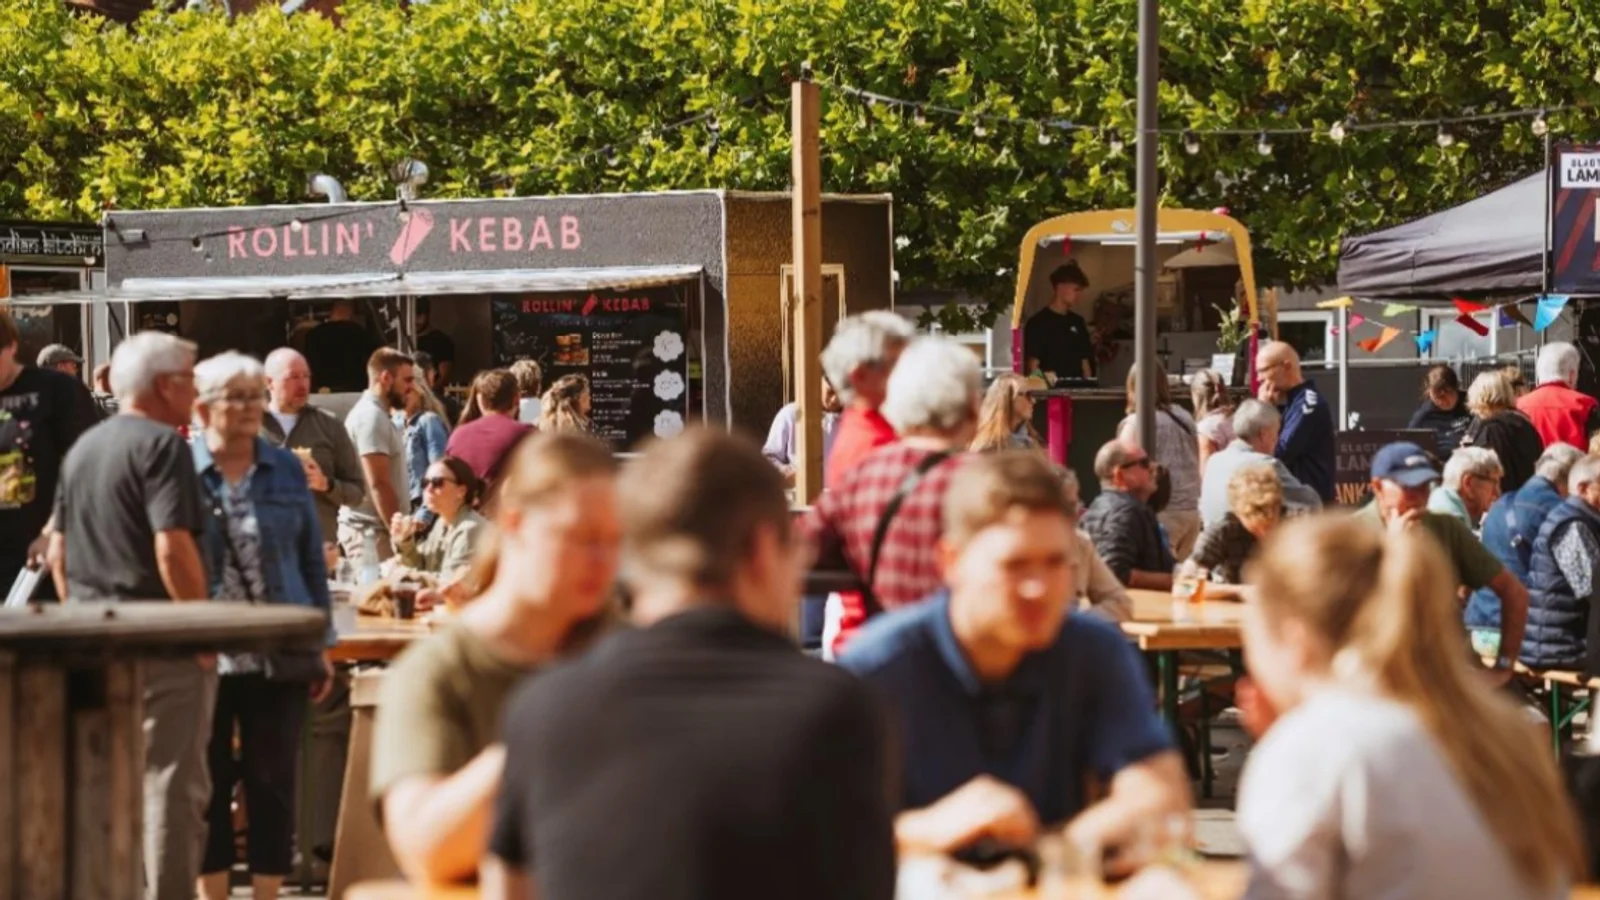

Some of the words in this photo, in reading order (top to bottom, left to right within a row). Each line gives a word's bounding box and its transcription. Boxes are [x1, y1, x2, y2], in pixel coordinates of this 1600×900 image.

[1567, 169, 1600, 182] LAM
[228, 220, 374, 258] ROLLIN'
[450, 215, 582, 251] KEBAB
[522, 298, 577, 313] ROLLIN'
[602, 297, 650, 312] KEBAB
